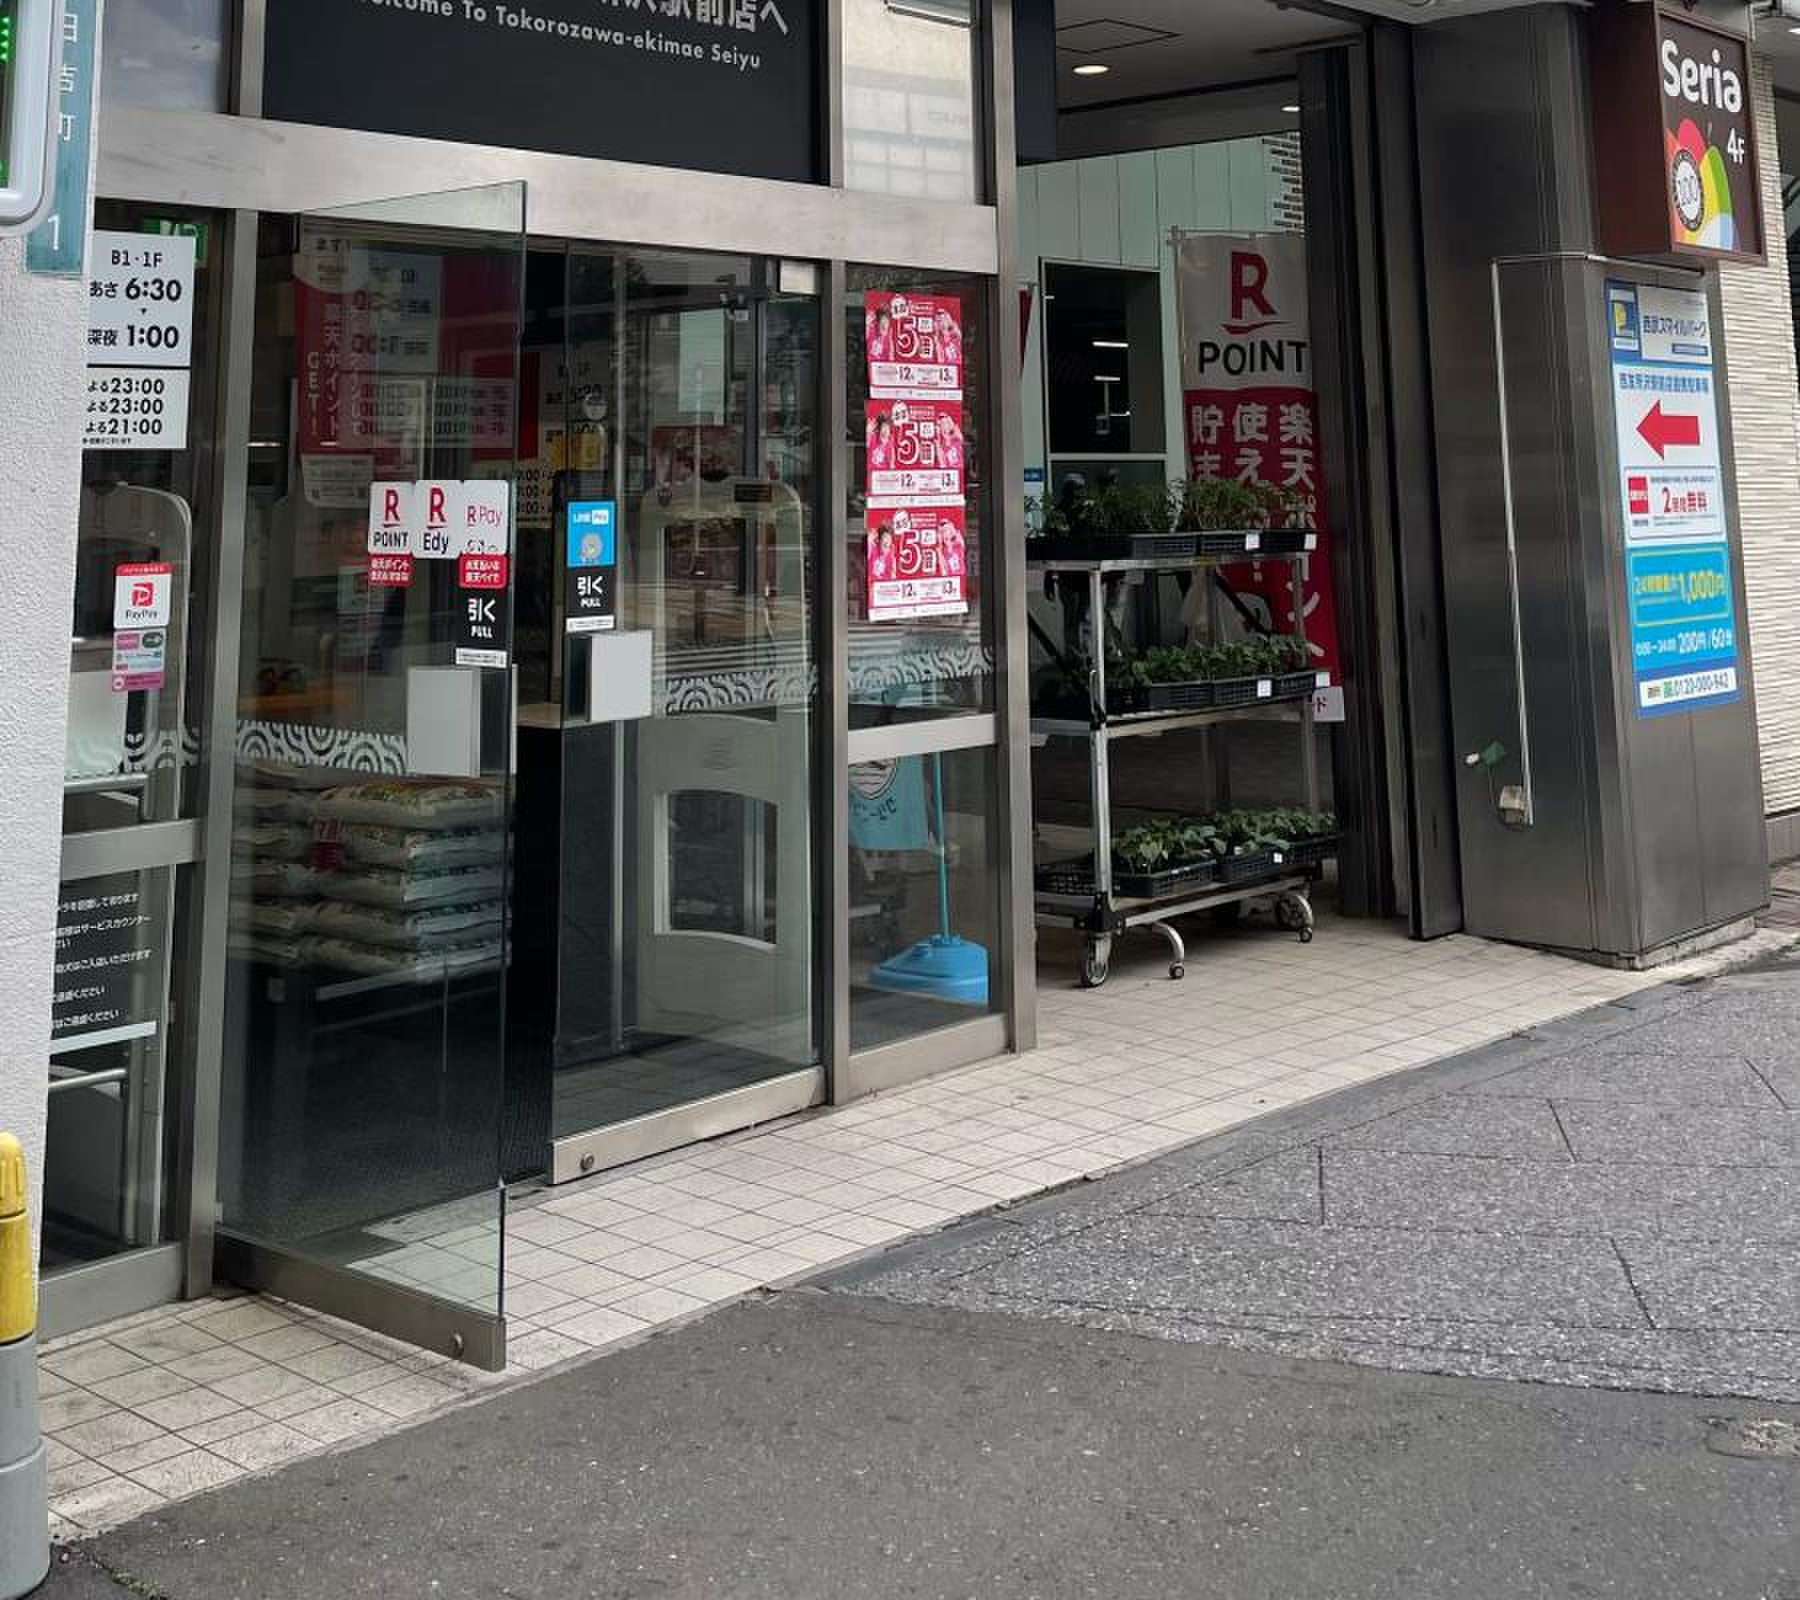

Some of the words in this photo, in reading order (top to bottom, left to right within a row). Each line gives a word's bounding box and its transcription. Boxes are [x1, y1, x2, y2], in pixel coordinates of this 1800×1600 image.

[463, 0, 487, 22] To
[496, 5, 704, 59] Tokorozawa-ekimae
[711, 43, 761, 72] Seiyu
[1661, 38, 1742, 113] Seria
[1727, 127, 1745, 165] 4F
[89, 280, 119, 299] あさ
[125, 277, 182, 303] 6:30
[87, 327, 118, 347] 深夜
[126, 324, 180, 349] 1:00
[1199, 340, 1307, 375] POINT
[373, 531, 408, 547] POINT
[423, 532, 449, 555] Edy
[577, 575, 604, 595] 引く
[126, 609, 158, 621] PayPay
[468, 598, 496, 622] 引く
[471, 625, 493, 638] PULL
